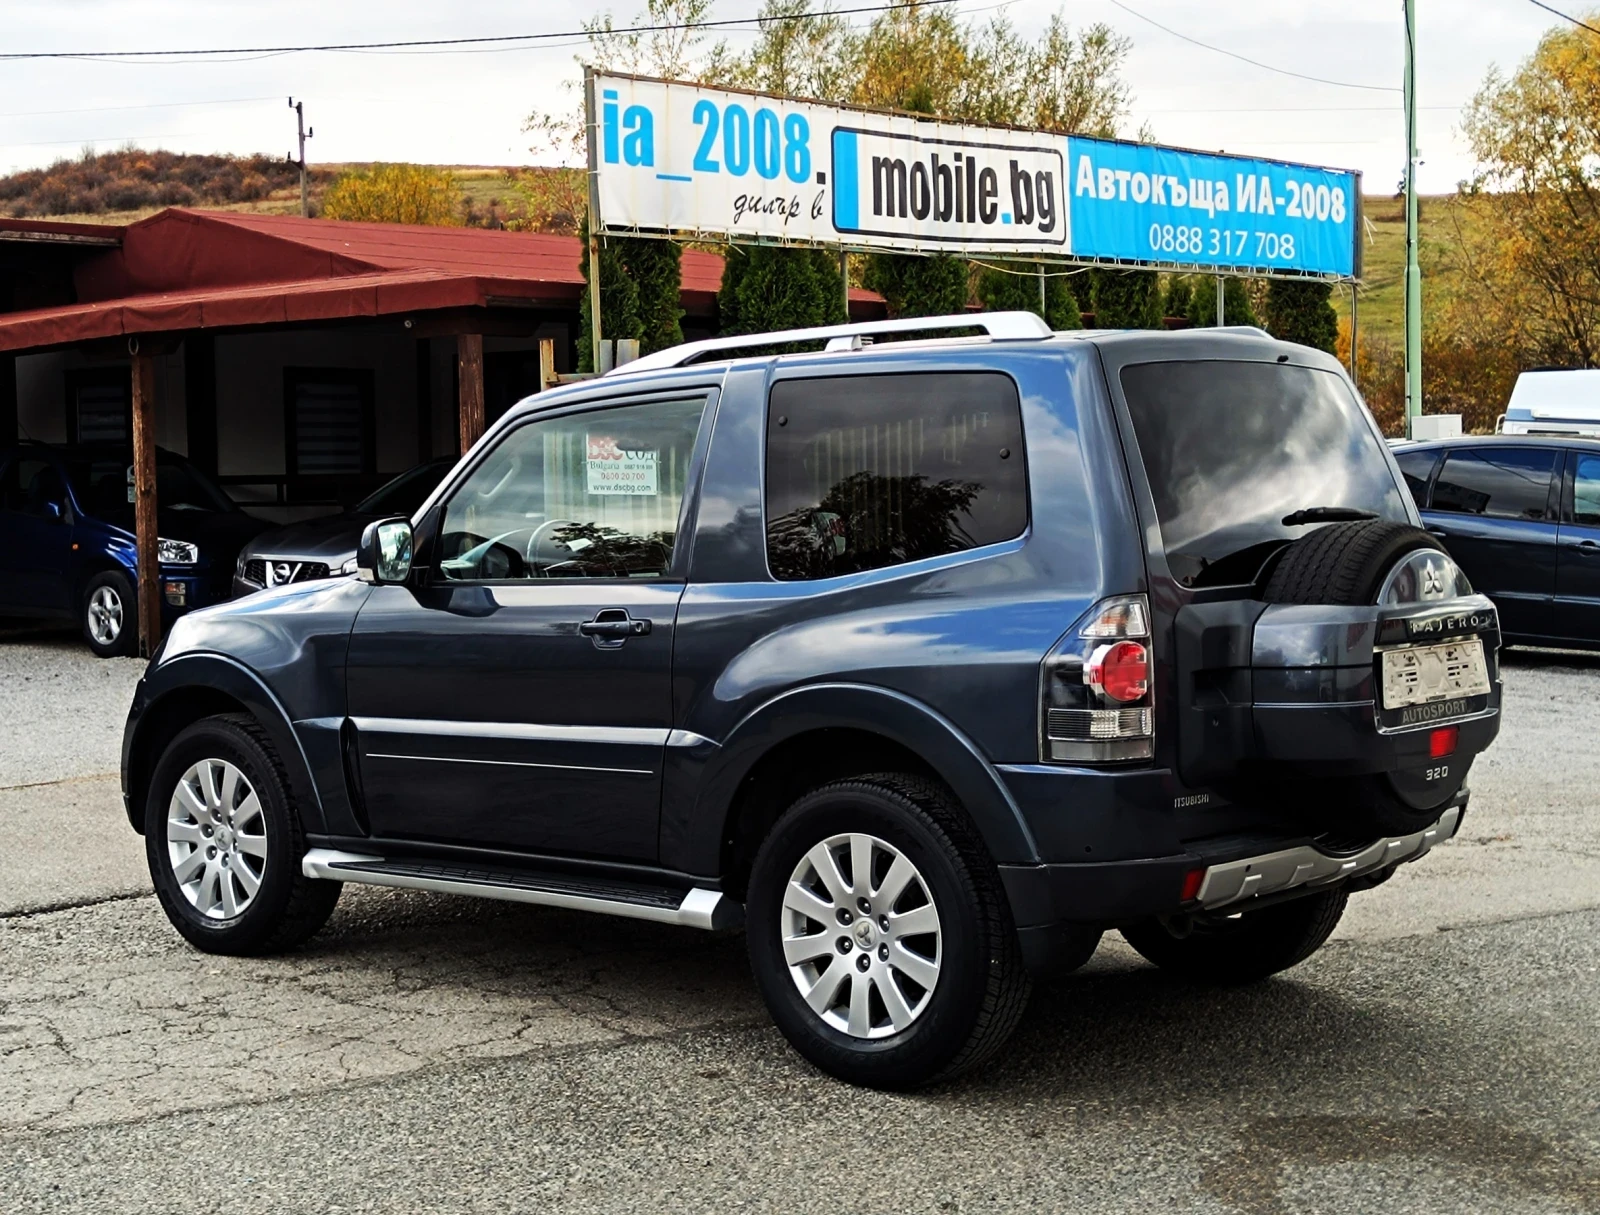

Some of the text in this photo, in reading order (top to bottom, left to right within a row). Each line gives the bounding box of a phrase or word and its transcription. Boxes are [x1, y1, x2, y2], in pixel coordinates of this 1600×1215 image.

[872, 152, 1056, 233] mobile.bg
[1075, 155, 1346, 224] Автокъща ИА-2008
[733, 193, 801, 226] дилър
[1149, 223, 1295, 260] 0888 317 708
[590, 461, 619, 471] Bulgaria
[1402, 700, 1467, 724] AUTOSPORT
[1426, 765, 1449, 781] 320
